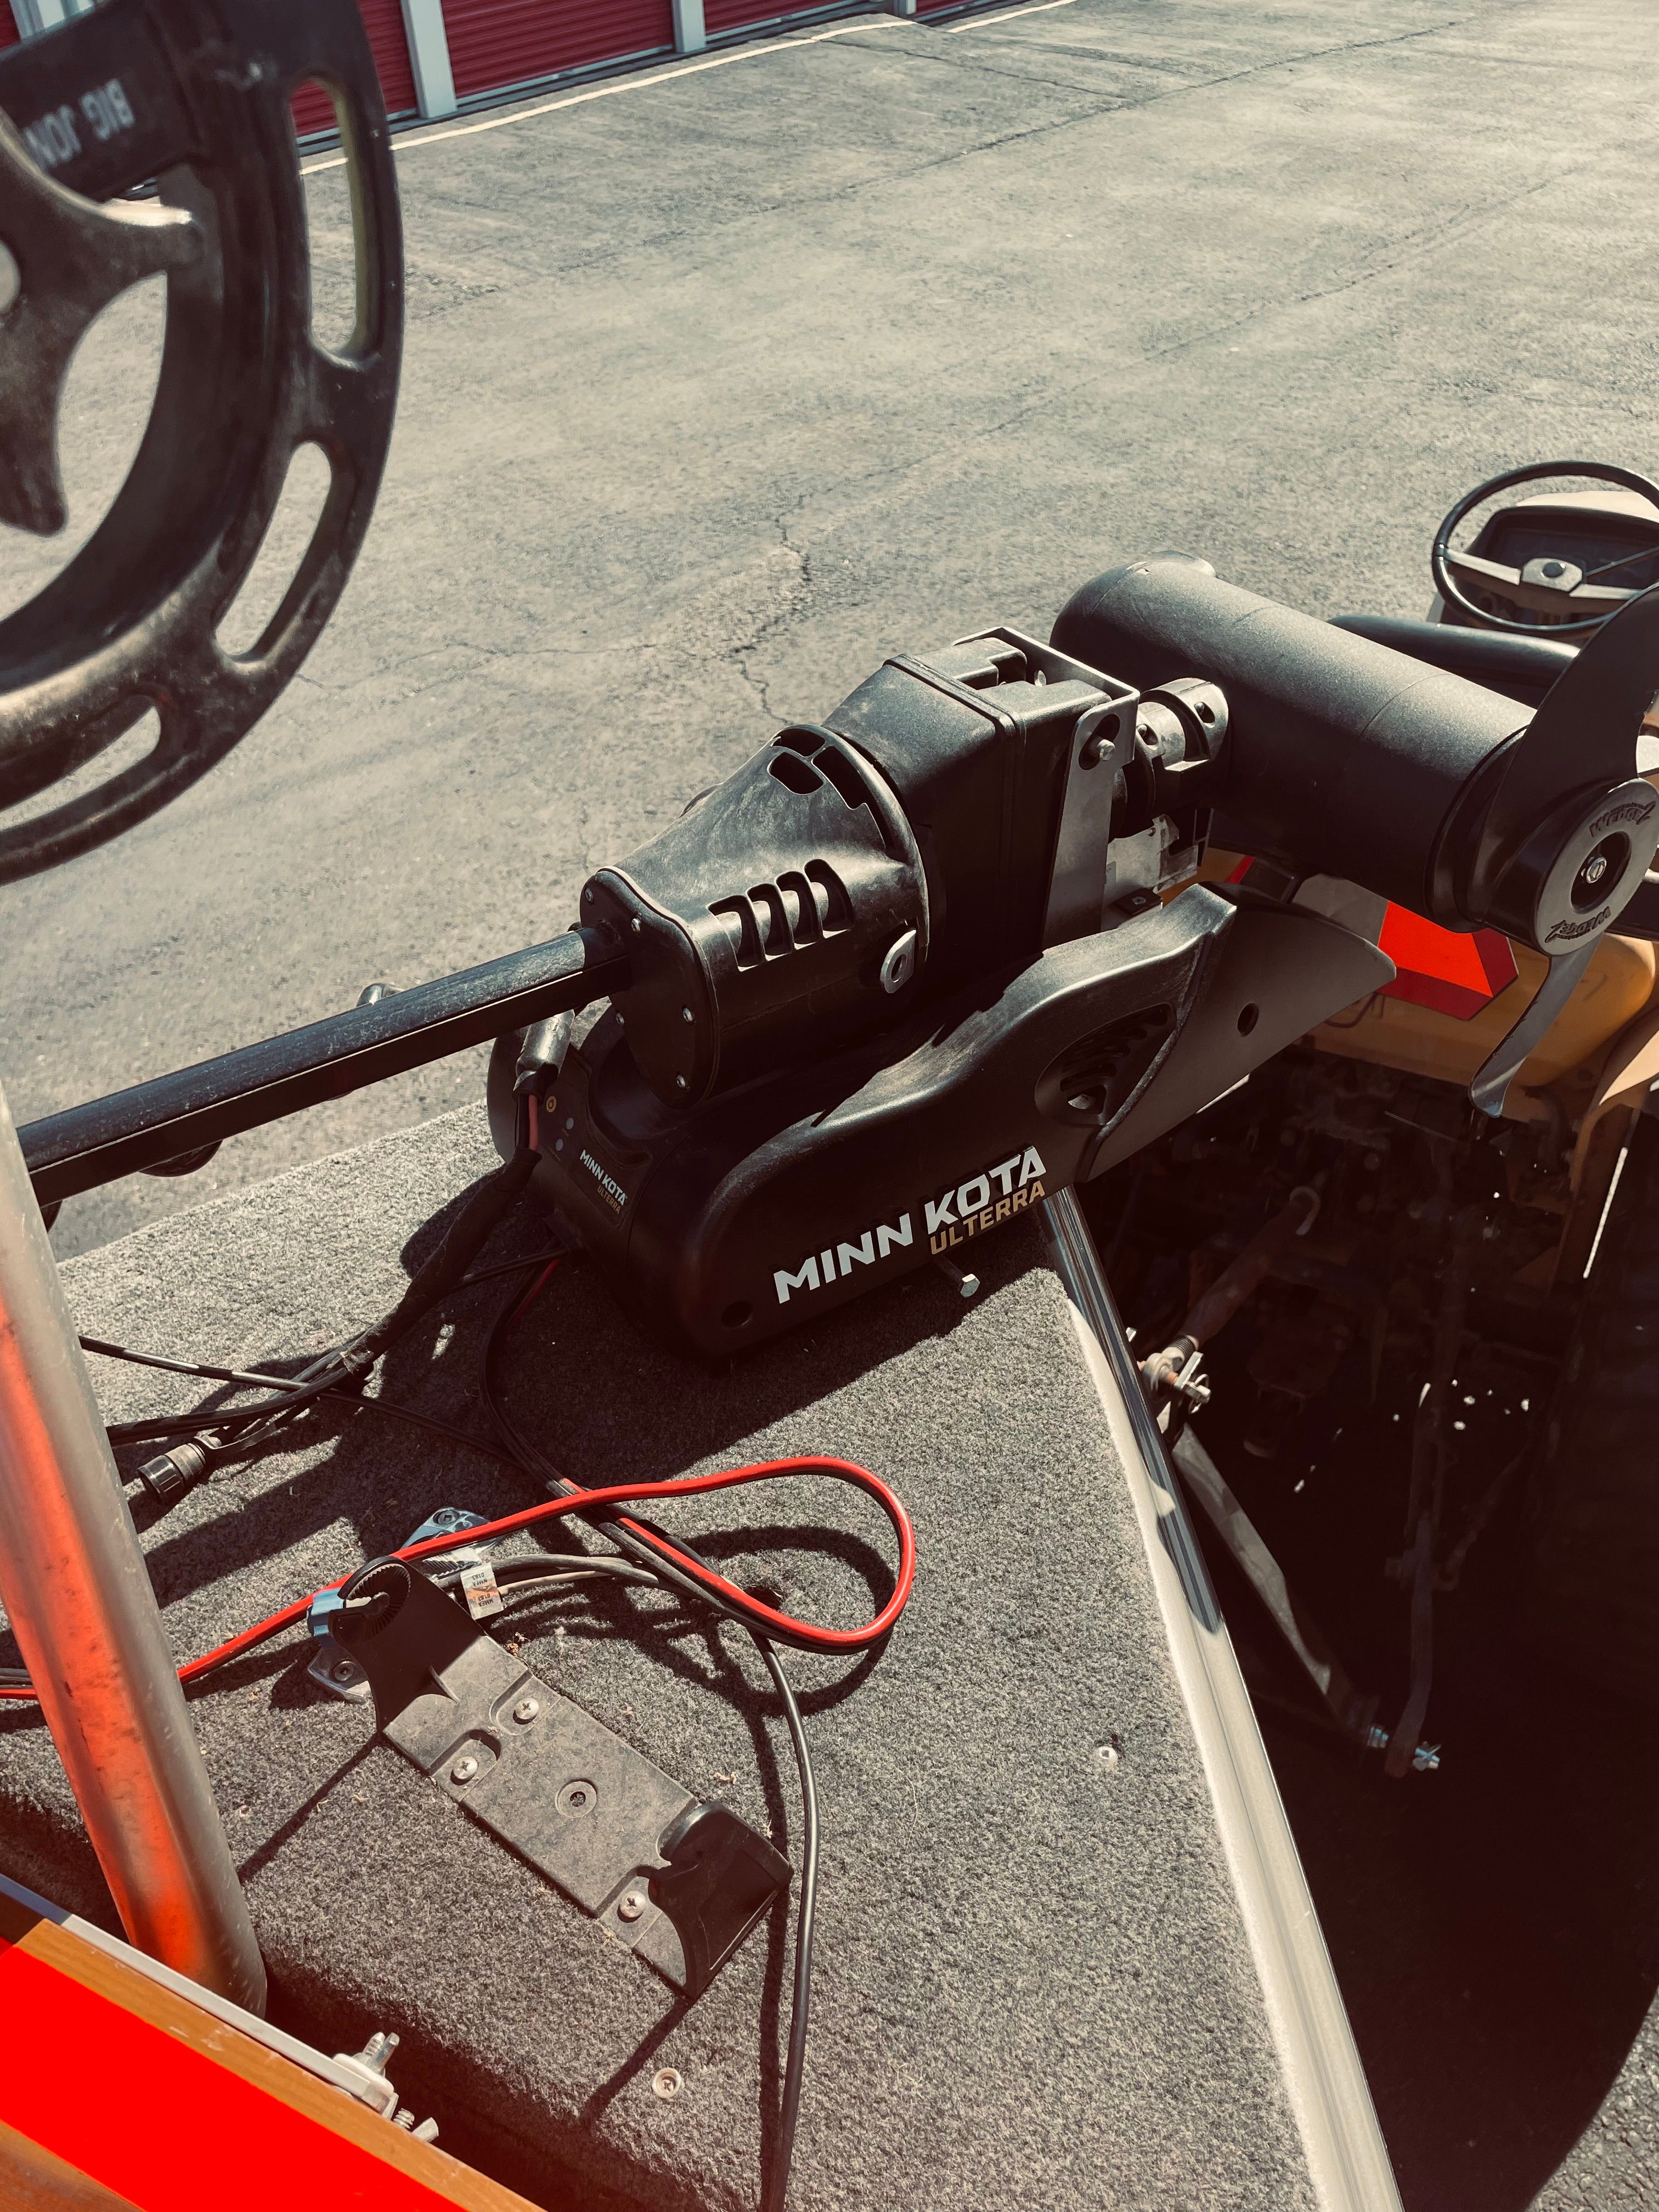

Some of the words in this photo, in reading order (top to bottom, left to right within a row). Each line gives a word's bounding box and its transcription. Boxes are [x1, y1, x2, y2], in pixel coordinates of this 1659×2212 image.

[80, 78, 135, 140] BIG
[1560, 906, 1611, 935] WEDGE
[579, 1149, 604, 1181] MINN
[602, 1173, 626, 1206] KOTA
[597, 1184, 621, 1214] ULTERRA
[774, 1213, 913, 1304] MINN
[924, 1146, 1046, 1234] KOTA
[930, 1180, 1046, 1255] ULTERRA
[472, 1578, 488, 1586] NMEA
[478, 1598, 493, 1607] NMEA
